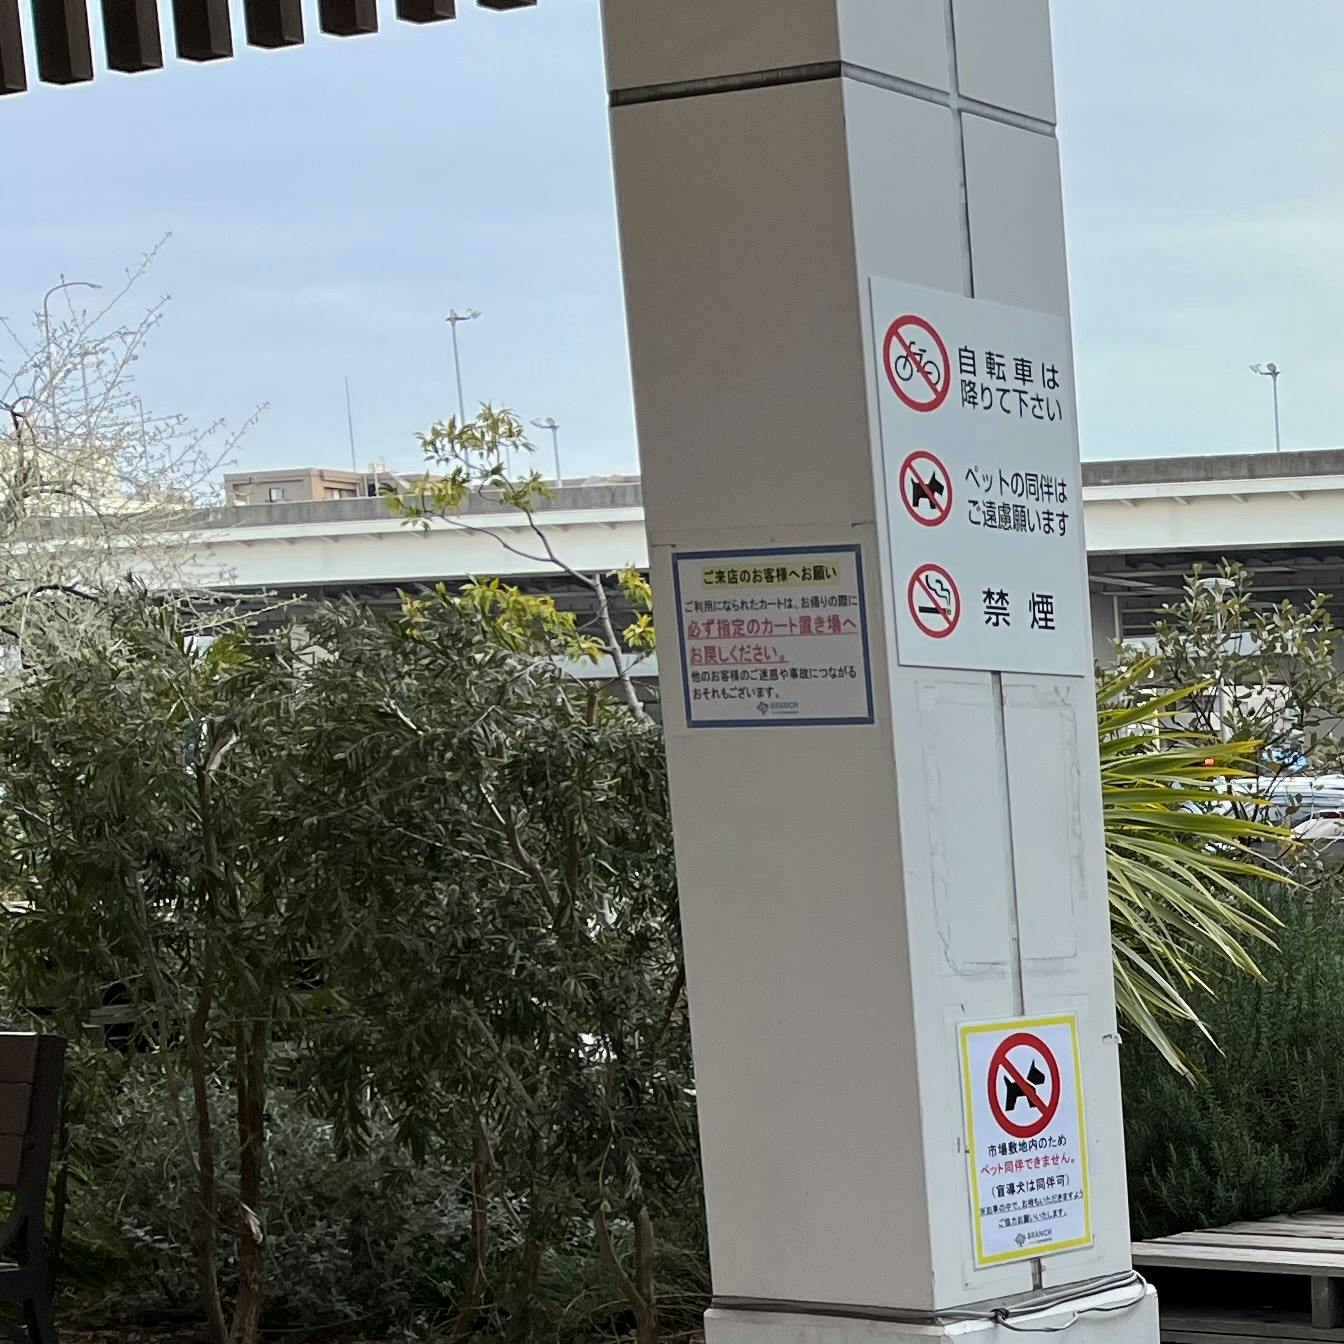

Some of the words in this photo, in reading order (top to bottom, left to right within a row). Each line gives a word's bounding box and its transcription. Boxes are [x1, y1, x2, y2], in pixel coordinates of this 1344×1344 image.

[957, 345, 1060, 390] 自転車は
[960, 380, 1063, 422] 降りて下さい
[964, 466, 1068, 503] ペットの同伴は
[967, 499, 1069, 537] ご遠慮願います
[703, 565, 838, 585] ご来店のお客様へお願い
[982, 588, 1056, 631] 禁煙
[687, 614, 857, 638] 必ず指定のカート置き場へ
[690, 645, 786, 665] お戻しください。
[691, 665, 857, 683] 他のお客様のご迷惑や事故につながる
[693, 686, 780, 700] おそれもございます。
[987, 1134, 1067, 1157] 市場敷地内のため
[980, 1152, 1075, 1176] ペット同伴できません。
